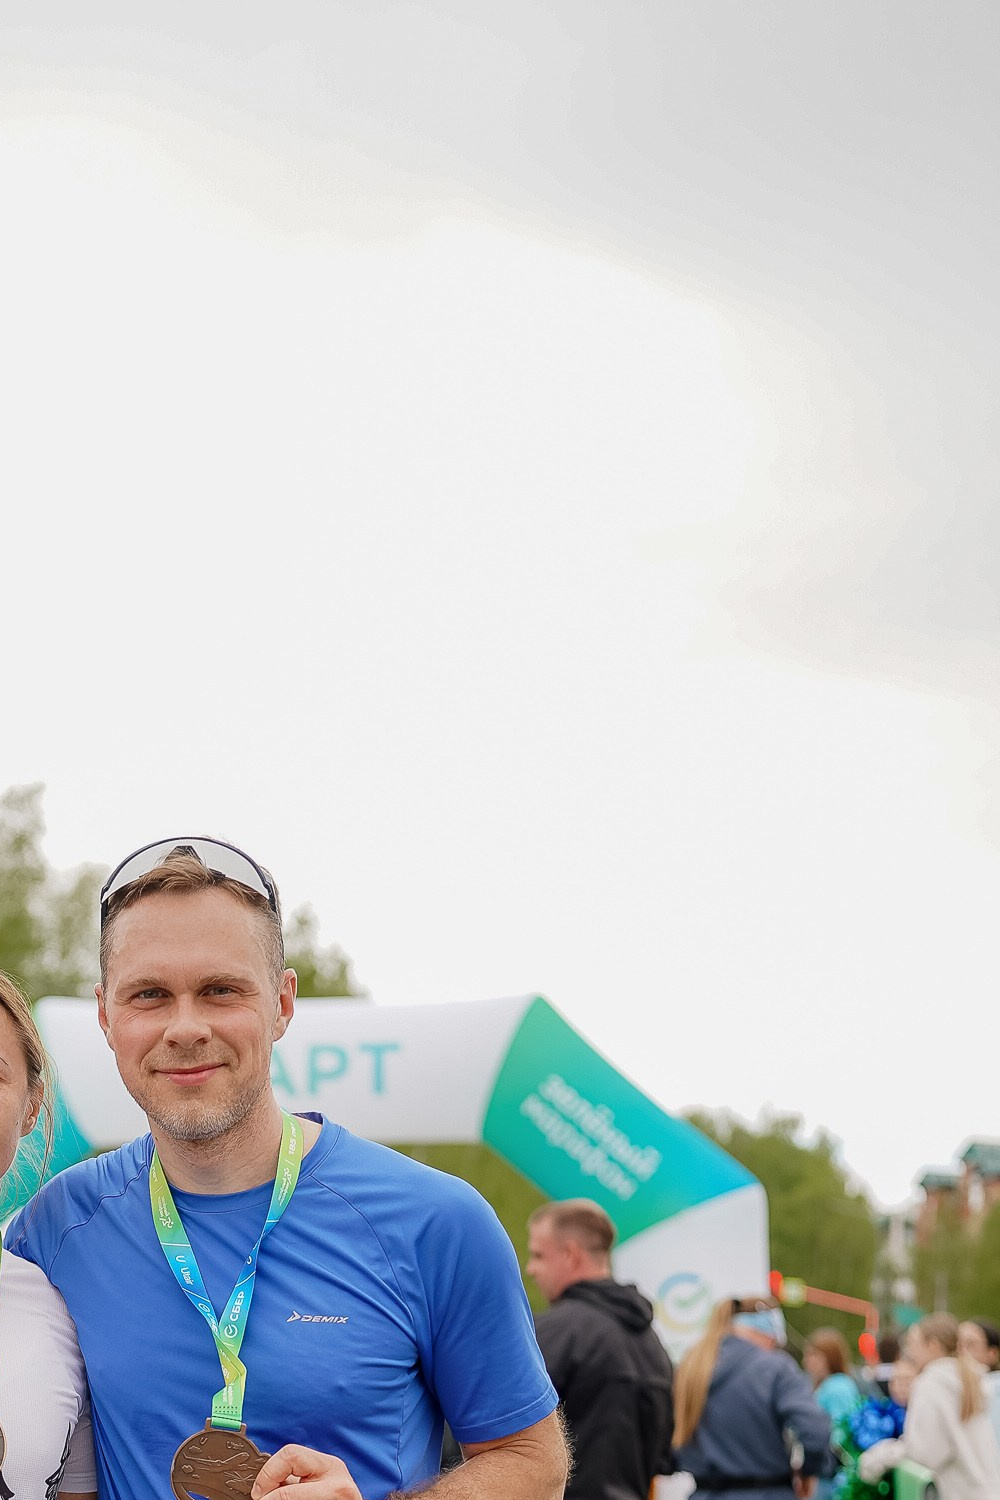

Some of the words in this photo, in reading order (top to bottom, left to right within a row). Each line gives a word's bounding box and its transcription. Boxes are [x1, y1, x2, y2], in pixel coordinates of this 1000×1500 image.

[271, 1041, 401, 1096] АРТ
[229, 1290, 245, 1322] СБЕР
[300, 1314, 349, 1324] DEMIX
